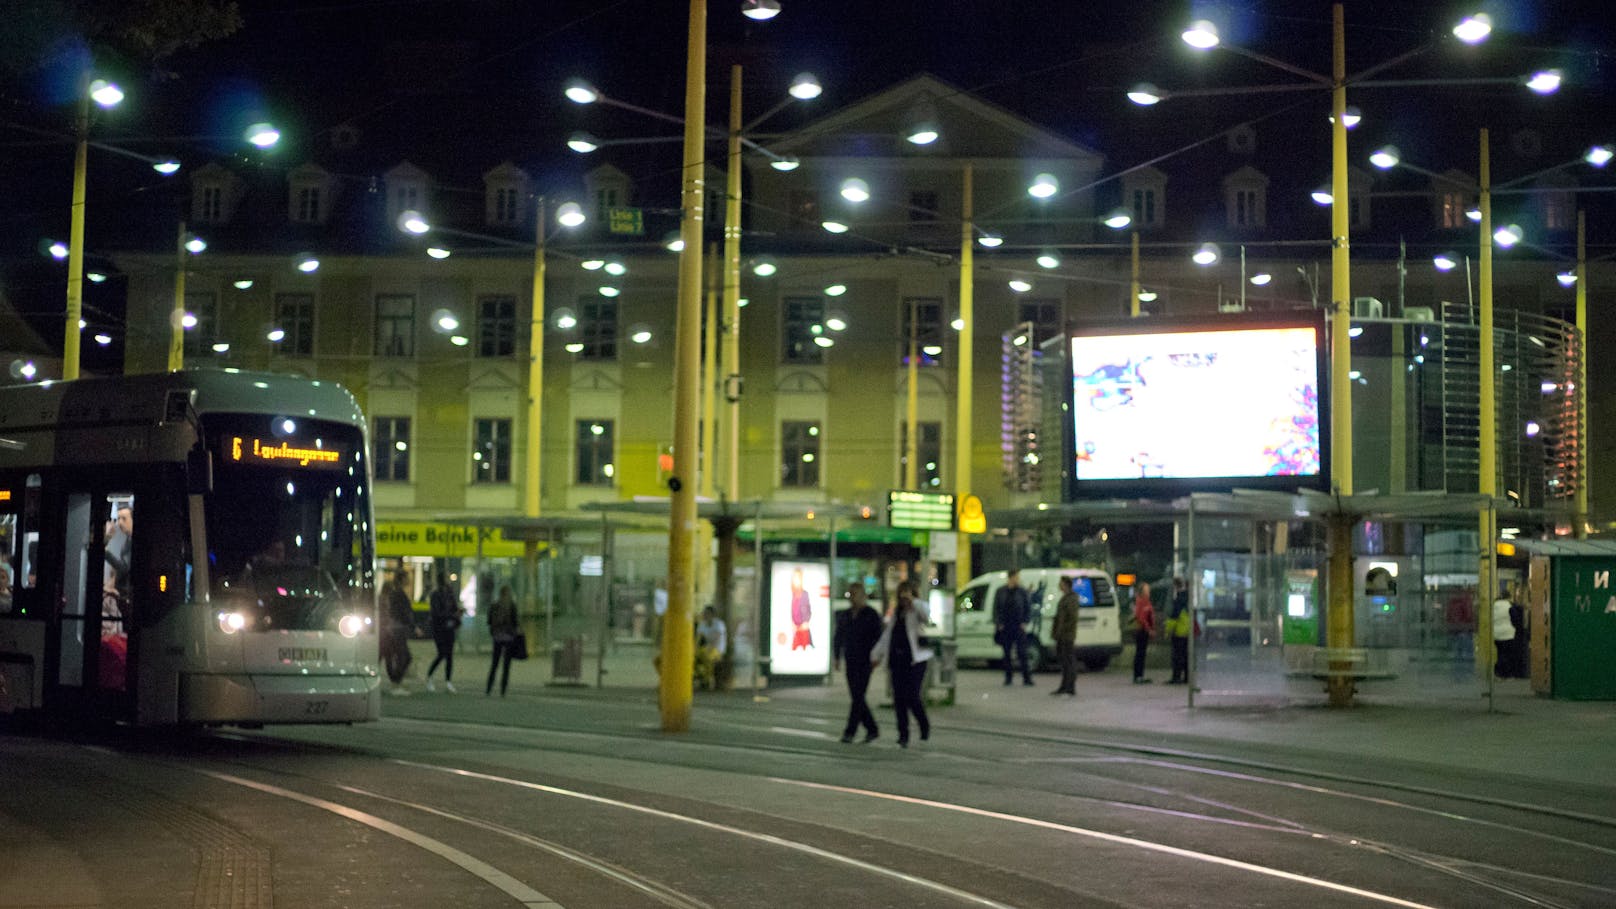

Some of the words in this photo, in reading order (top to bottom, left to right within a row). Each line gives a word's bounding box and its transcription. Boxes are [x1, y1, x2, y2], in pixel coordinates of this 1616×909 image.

[232, 437, 242, 460] 6
[376, 525, 418, 542] eine
[426, 527, 474, 543] Bank
[306, 701, 328, 713] 227
